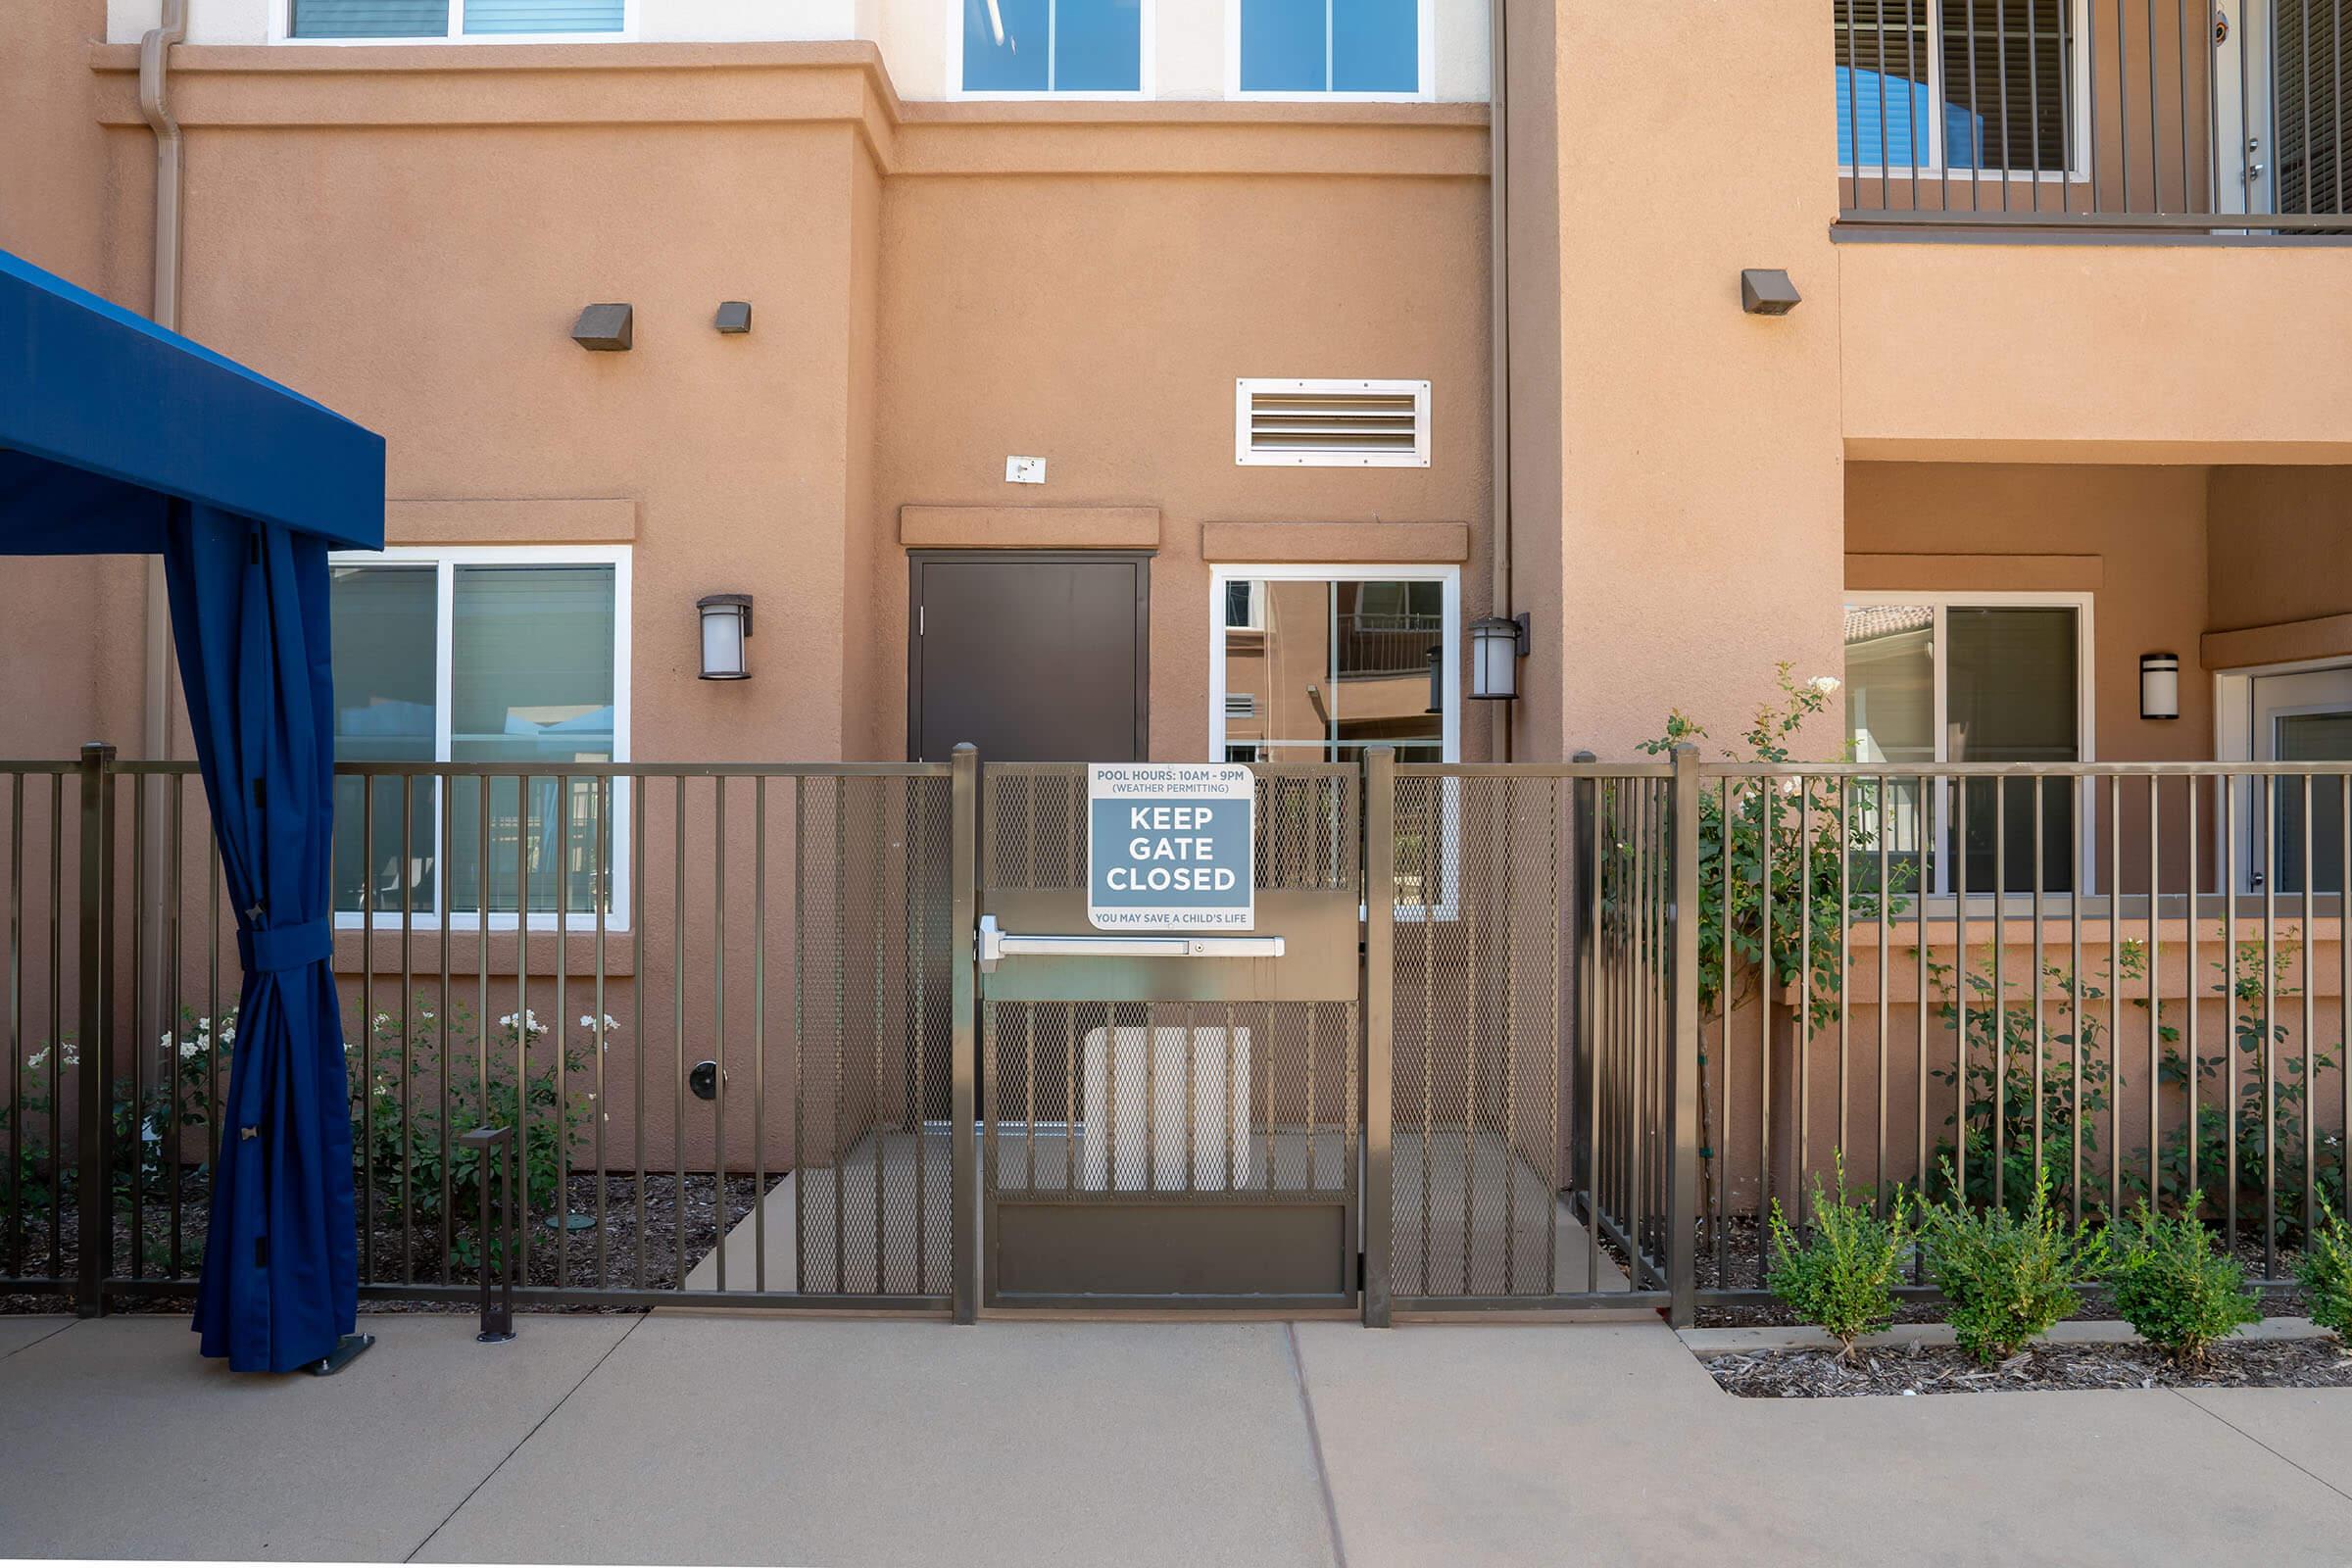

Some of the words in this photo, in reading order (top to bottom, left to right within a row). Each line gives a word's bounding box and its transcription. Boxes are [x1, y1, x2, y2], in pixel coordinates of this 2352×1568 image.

[1098, 770, 1129, 781] POOL
[1132, 770, 1176, 781] HOURS:
[1179, 770, 1209, 781] 10AM
[1220, 770, 1244, 781] 9PM
[1112, 783, 1164, 794] (WEATHER
[1167, 783, 1229, 794] PERMITTING)
[1131, 807, 1213, 830] KEEP
[1129, 837, 1213, 860] GATE
[1106, 867, 1236, 891] CLOSED
[1096, 913, 1117, 923] YOU
[1120, 913, 1142, 923] MAY
[1145, 913, 1170, 923] SAVE
[1172, 913, 1180, 923] A
[1183, 913, 1222, 923] CHILD'S
[1225, 913, 1247, 923] LIFE
